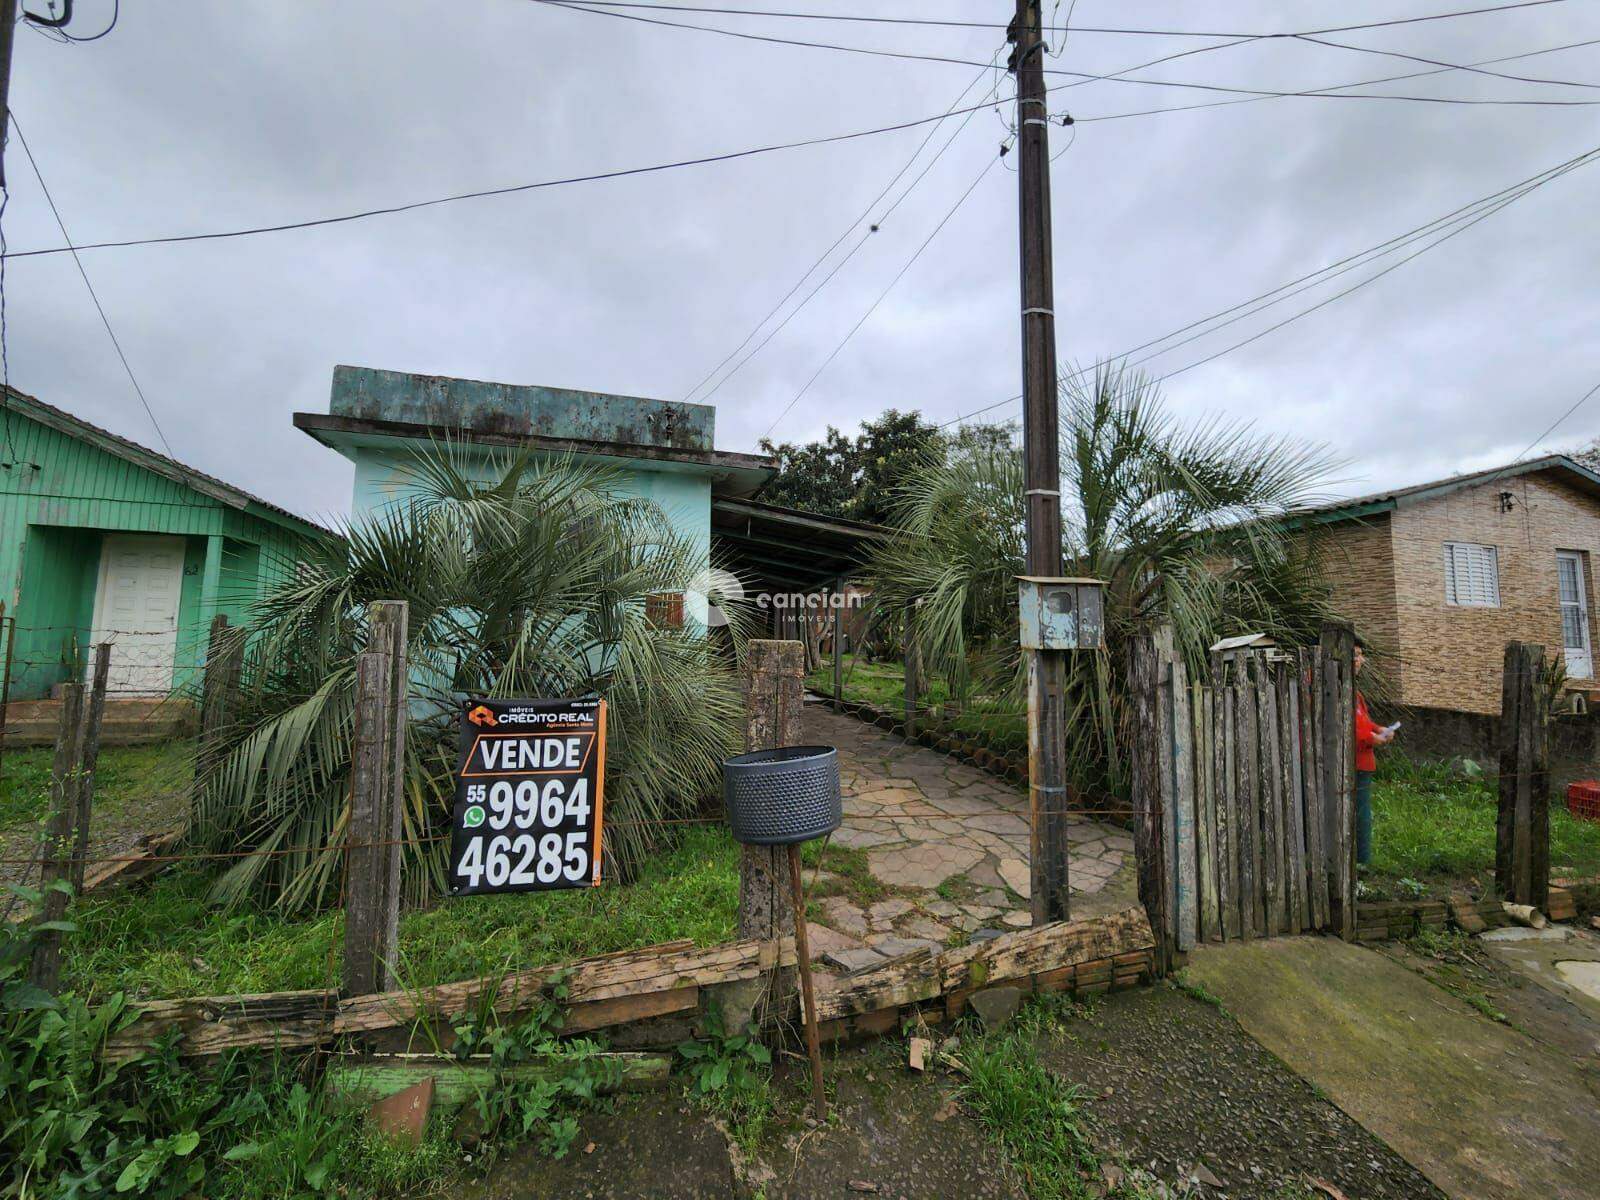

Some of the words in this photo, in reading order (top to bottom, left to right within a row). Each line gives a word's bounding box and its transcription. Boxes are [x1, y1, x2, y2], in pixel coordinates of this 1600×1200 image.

[498, 713, 557, 723] CRÉDITO
[559, 713, 594, 722] REAL
[481, 738, 581, 769] VENDE
[466, 784, 486, 803] 55
[489, 778, 590, 831] 9964
[457, 832, 588, 887] 46285
